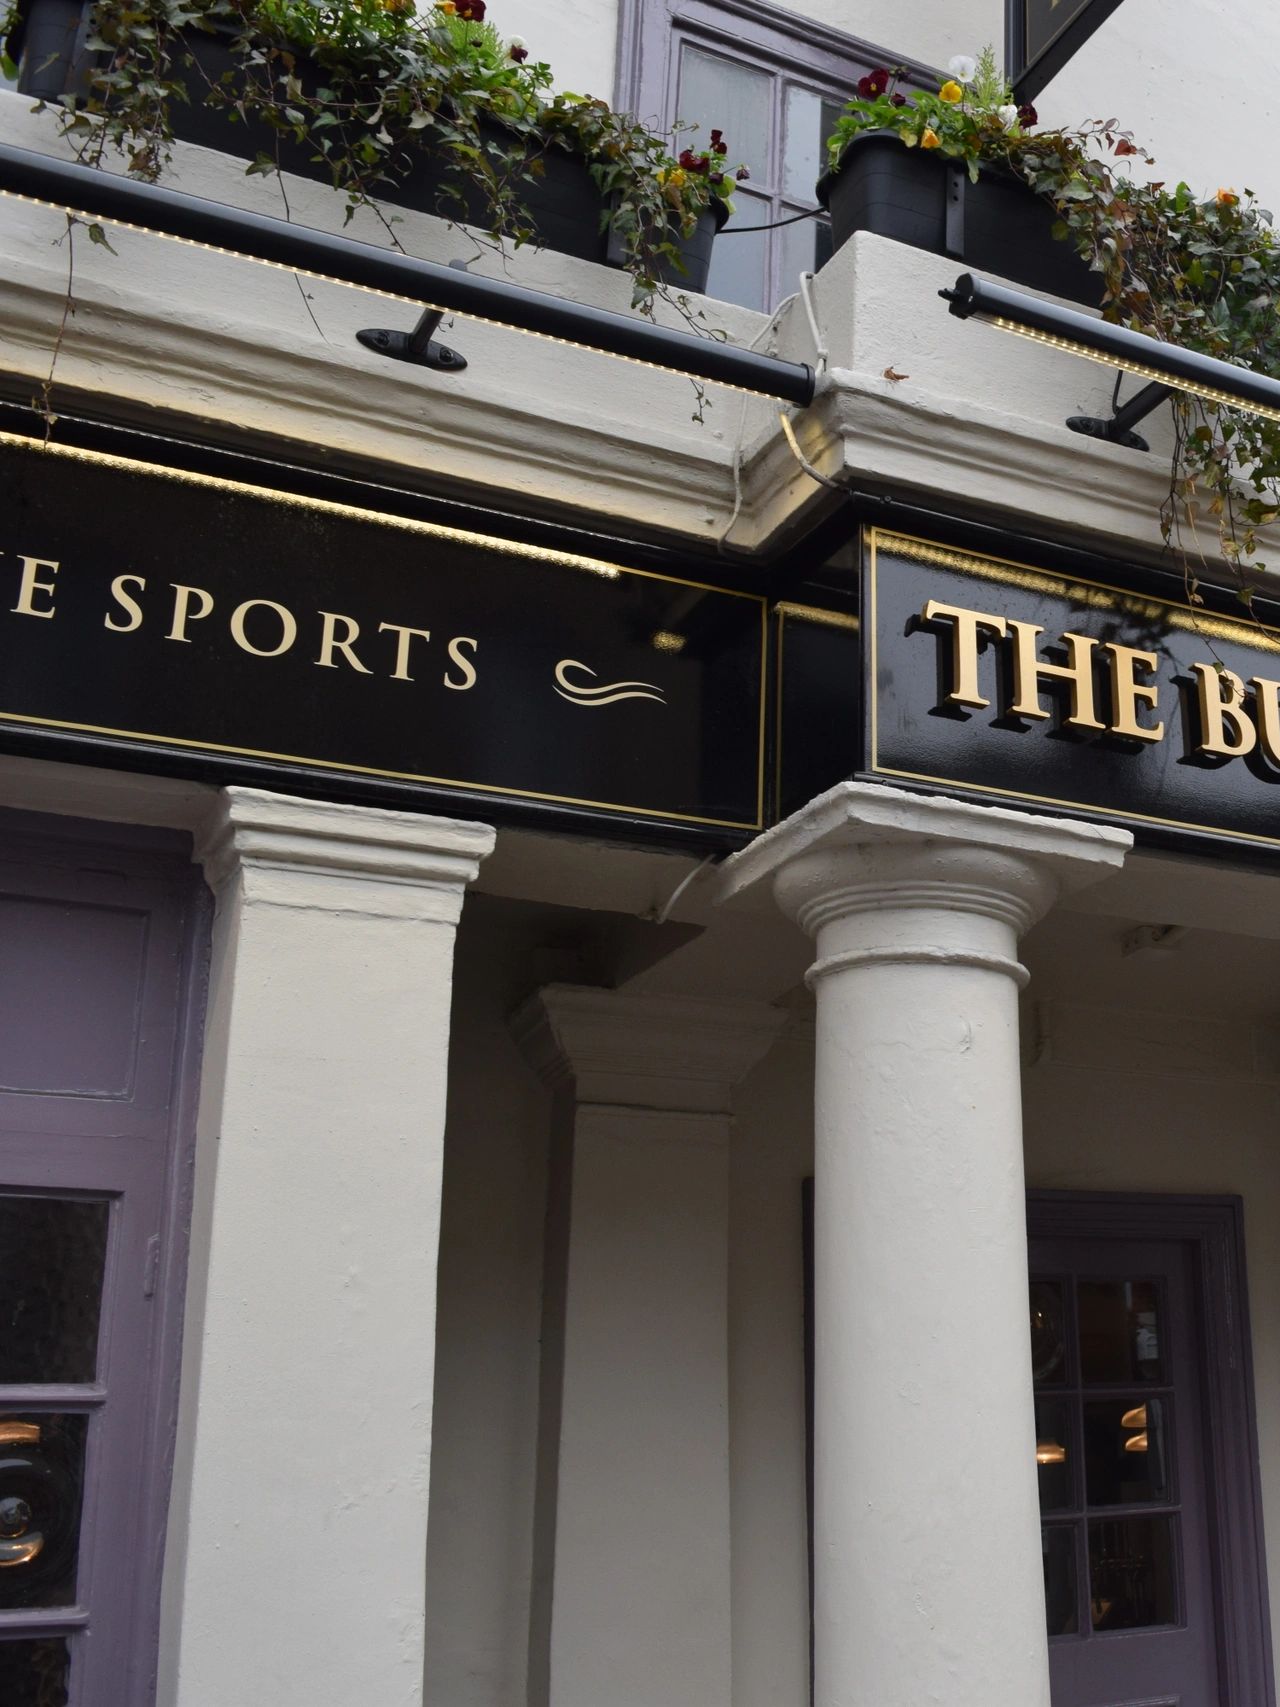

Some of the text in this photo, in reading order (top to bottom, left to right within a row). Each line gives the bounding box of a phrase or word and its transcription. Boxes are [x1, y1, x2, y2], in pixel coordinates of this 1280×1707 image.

[0, 551, 479, 691] E SPORTS
[921, 600, 1165, 741] THE
